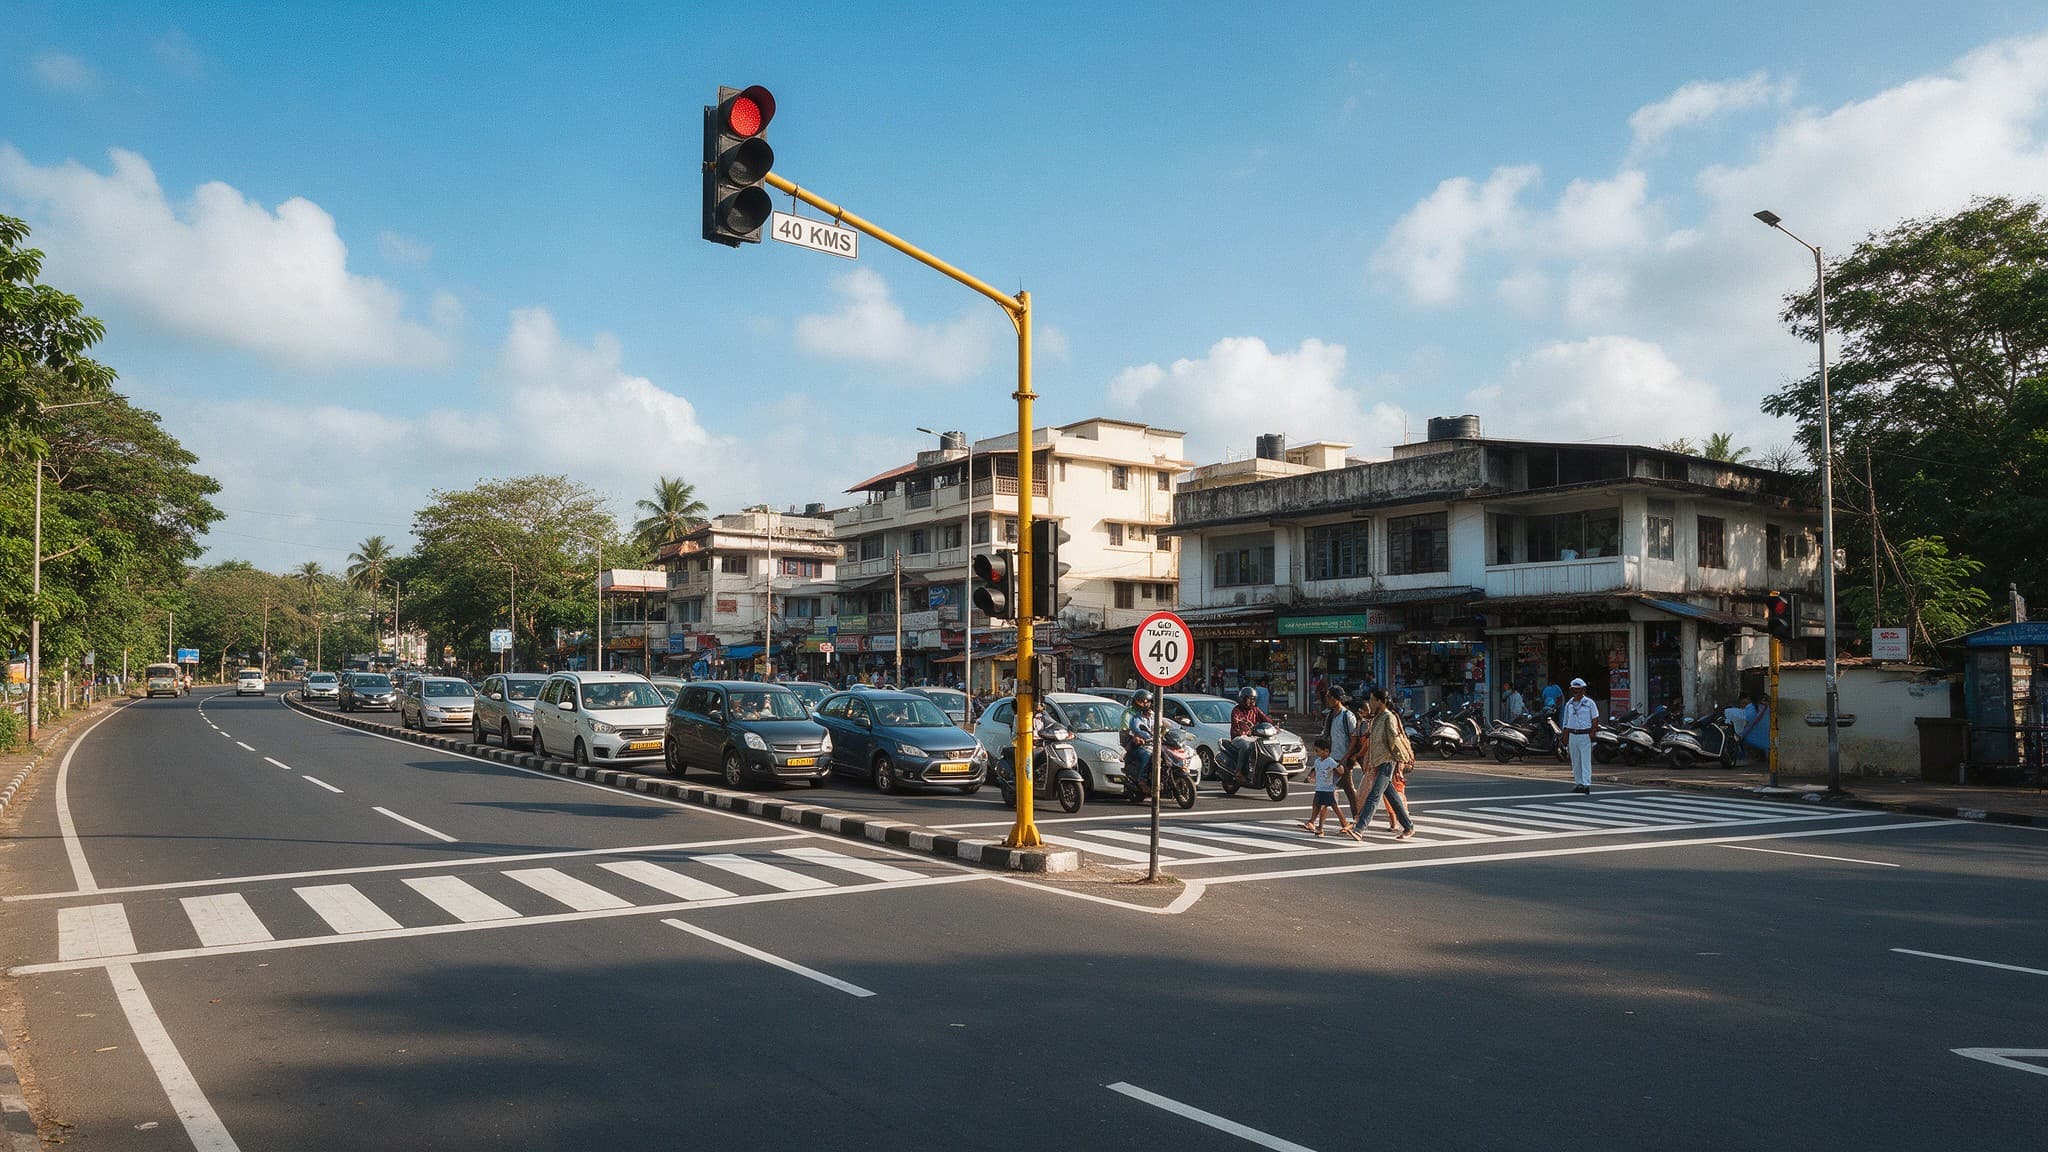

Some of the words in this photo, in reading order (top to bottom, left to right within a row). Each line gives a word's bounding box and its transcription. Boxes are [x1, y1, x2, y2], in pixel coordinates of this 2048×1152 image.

[779, 220, 802, 240] 40
[810, 227, 851, 251] KMS
[1148, 639, 1178, 662] 40
